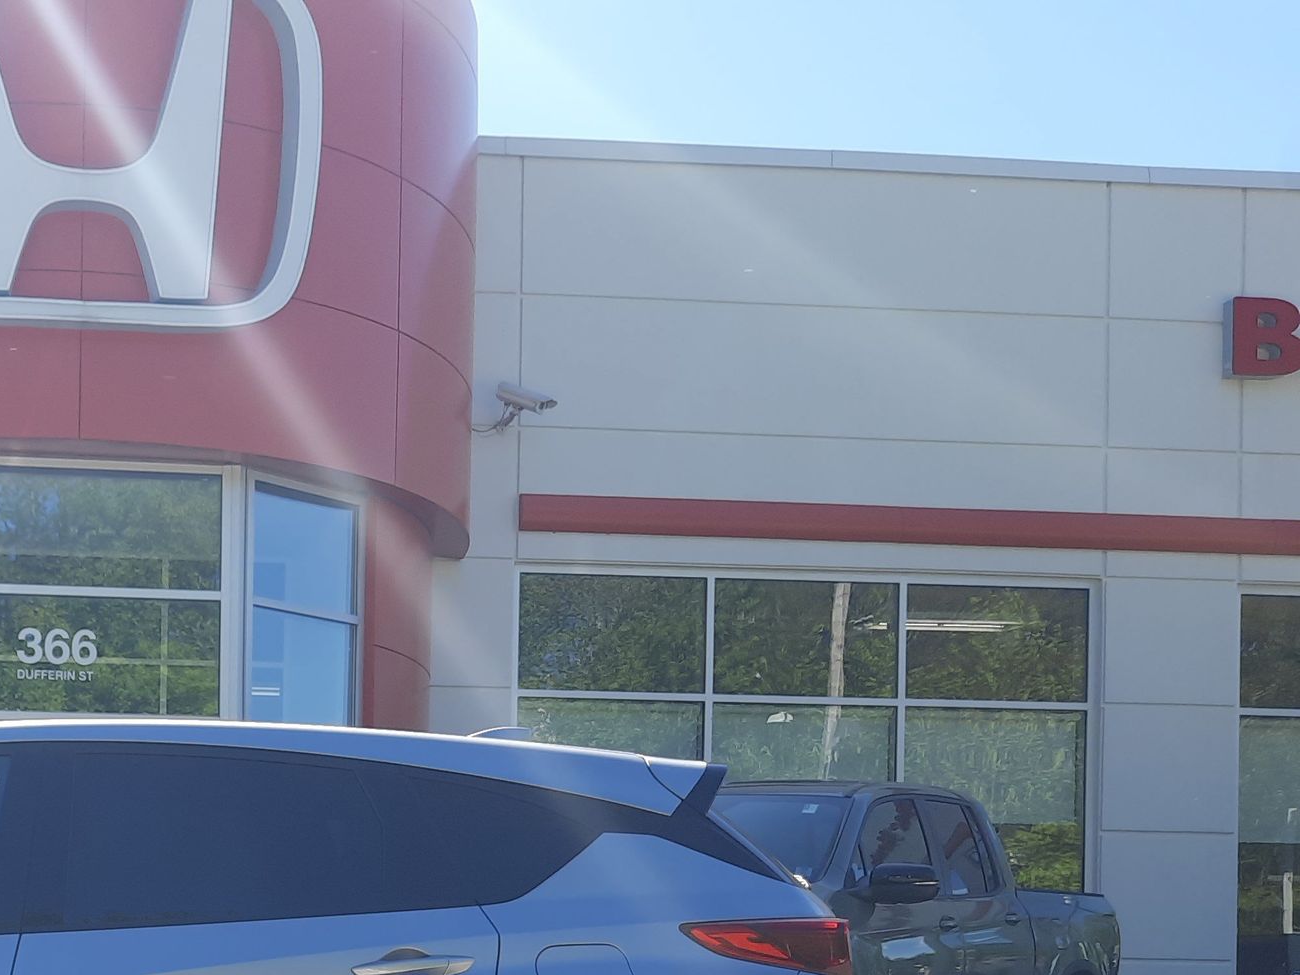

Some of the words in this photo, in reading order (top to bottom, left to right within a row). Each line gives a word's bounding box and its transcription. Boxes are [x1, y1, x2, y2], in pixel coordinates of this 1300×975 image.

[16, 626, 98, 666] 366
[16, 668, 76, 681] DUFFERIN
[78, 671, 94, 682] ST
